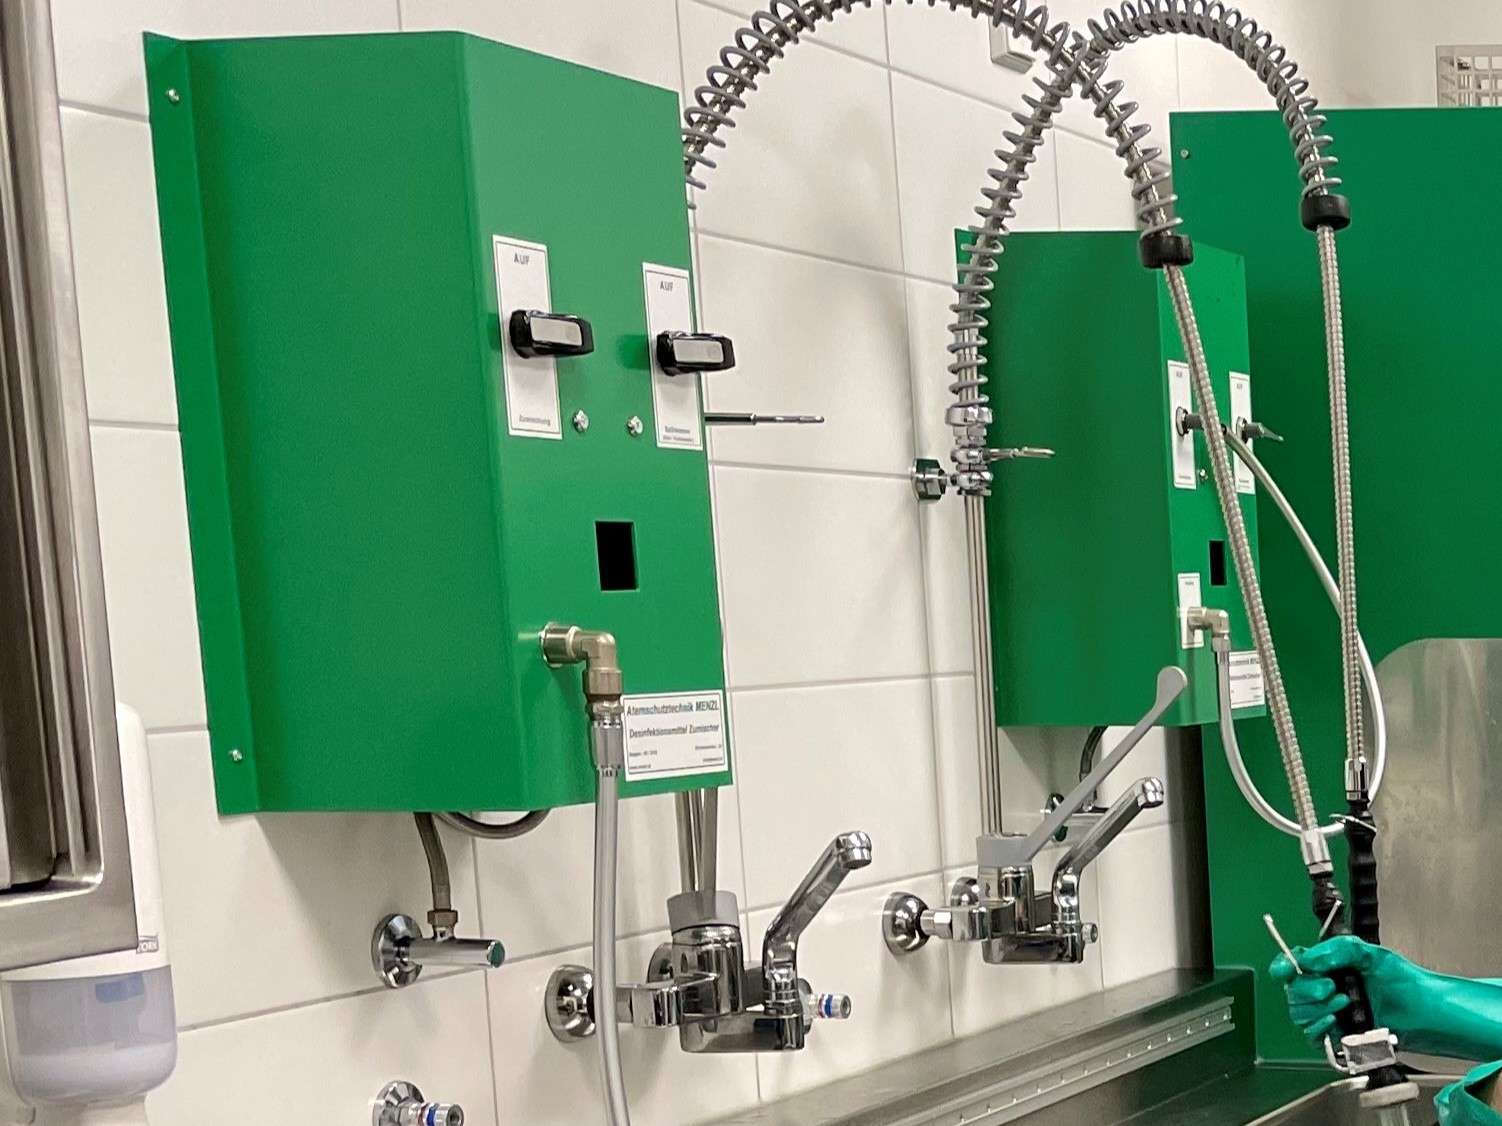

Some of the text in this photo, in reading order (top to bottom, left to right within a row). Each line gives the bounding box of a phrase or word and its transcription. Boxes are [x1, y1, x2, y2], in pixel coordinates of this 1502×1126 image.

[514, 252, 530, 265] AUF
[660, 280, 673, 292] AUF
[627, 703, 694, 716] Atemschutztechnik
